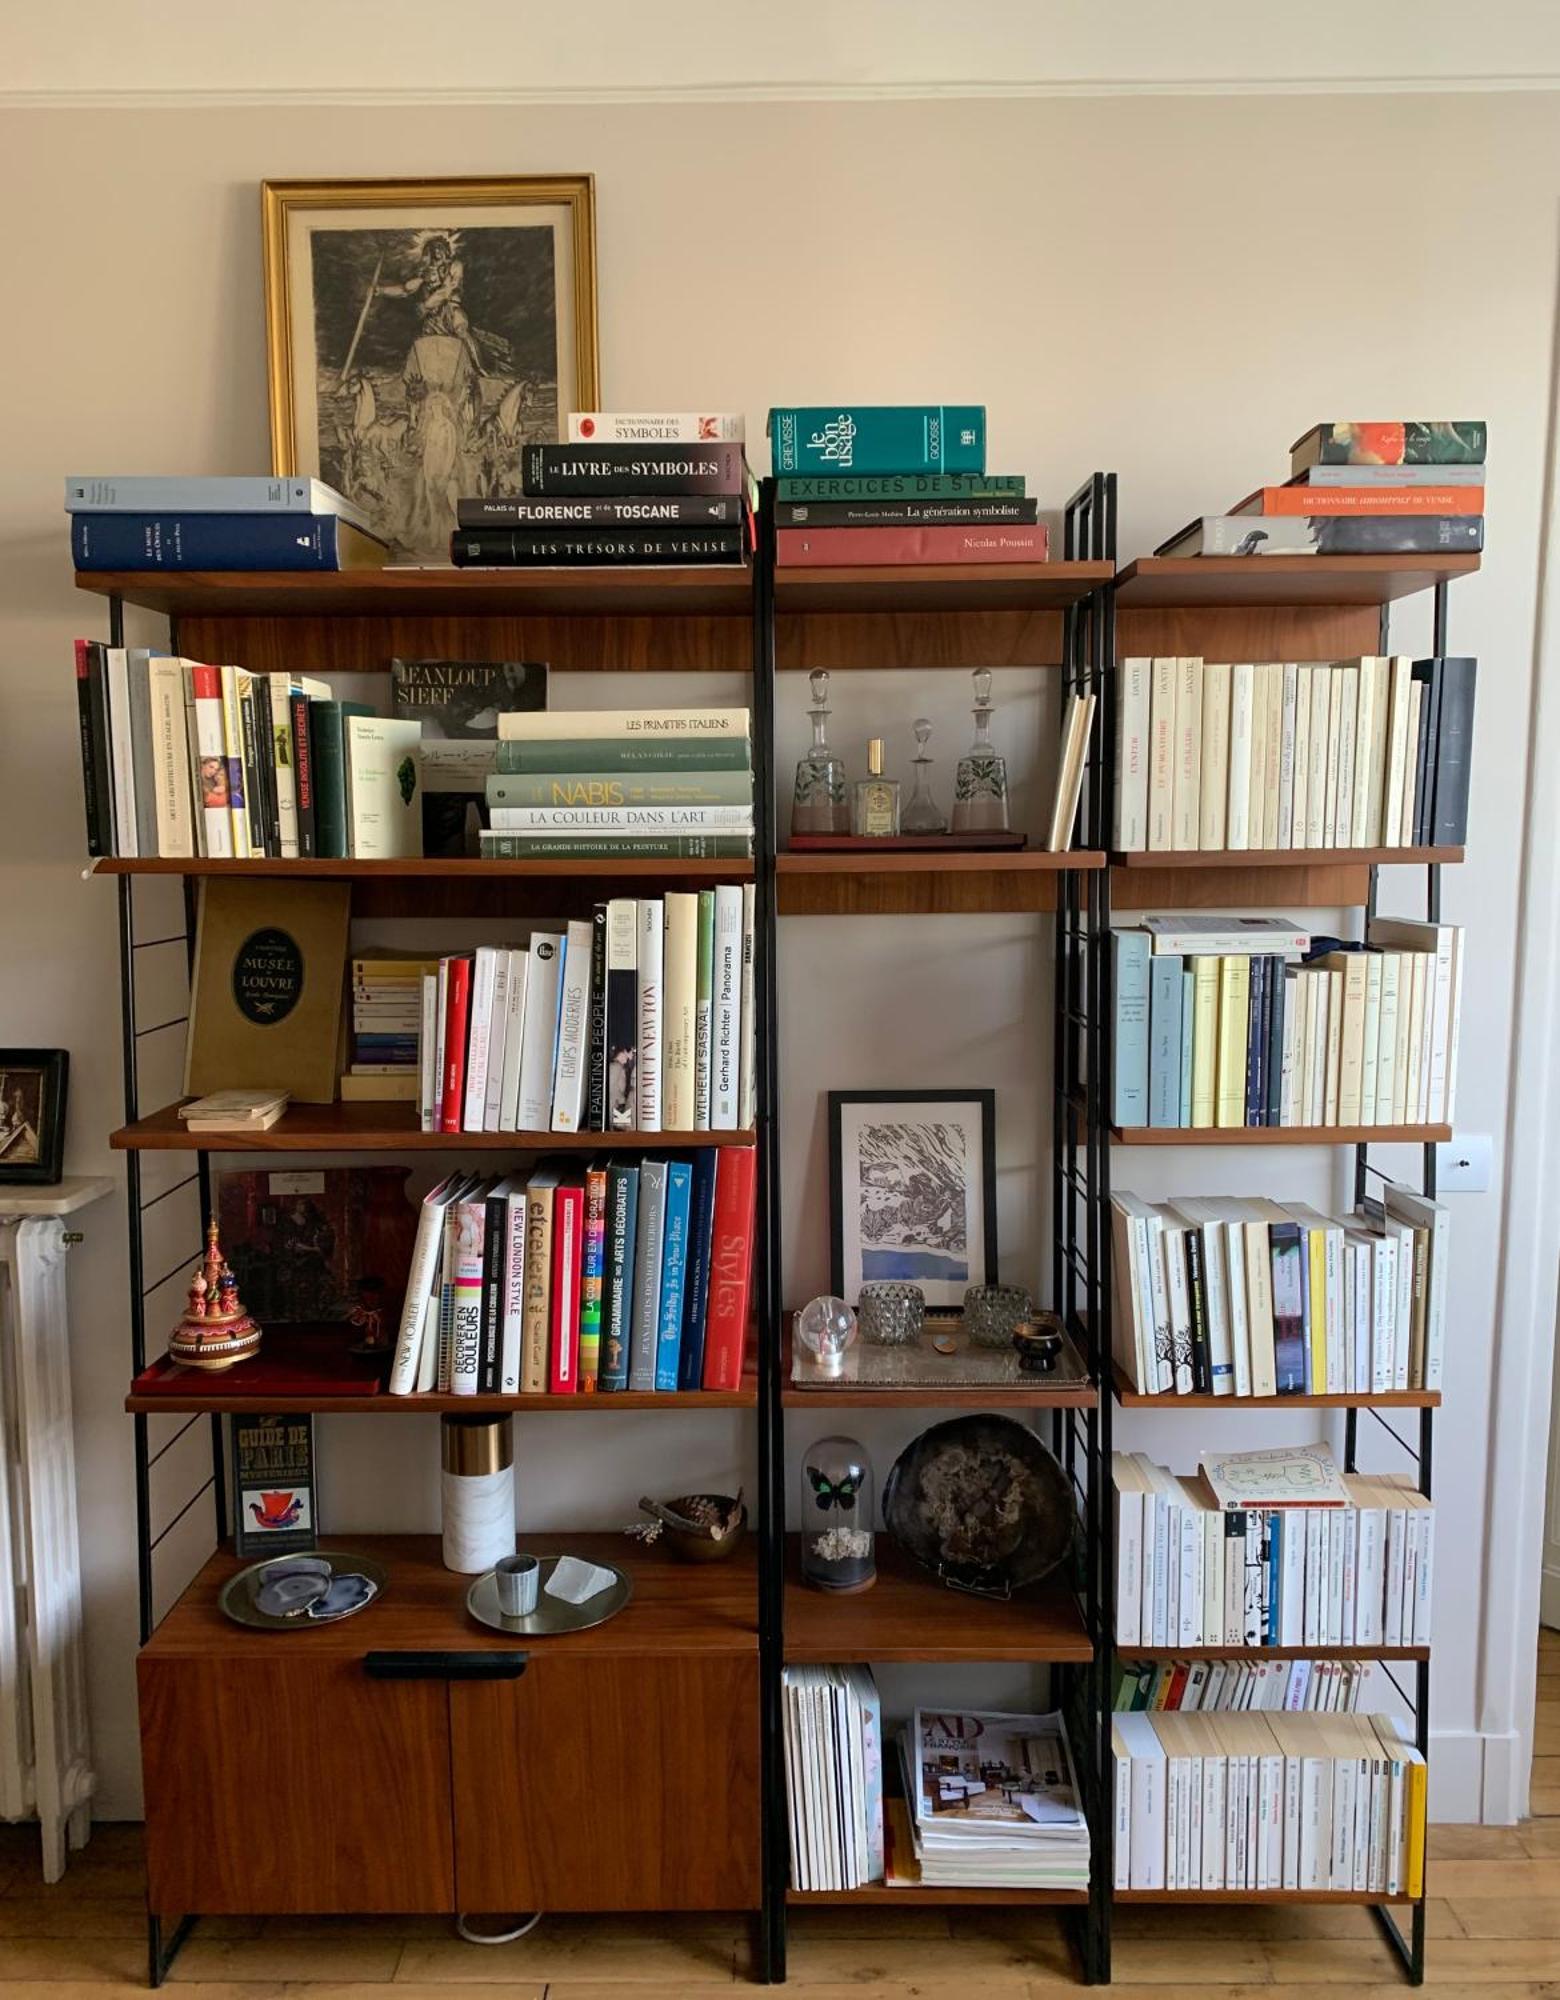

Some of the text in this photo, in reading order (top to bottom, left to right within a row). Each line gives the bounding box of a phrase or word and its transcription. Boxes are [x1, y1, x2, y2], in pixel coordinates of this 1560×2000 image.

[615, 426, 680, 439] SYMBOLES
[782, 414, 794, 470] GREVISSE
[806, 432, 826, 449] le
[820, 422, 840, 461] bon
[837, 413, 857, 467] usage
[929, 417, 941, 460] GOOSSE
[550, 462, 719, 476] LE LIVRE DES SYMBOLES
[789, 475, 1017, 497] EXERCICES DE STYLE
[484, 504, 508, 512] PALAIS
[518, 505, 593, 520] FLORENCE
[614, 505, 680, 518] TOSCANE
[907, 506, 921, 517] La
[922, 505, 971, 520] génération
[972, 504, 1020, 520] symboliste
[531, 540, 728, 555] LES TRÉSORS DE VENISE
[963, 537, 1034, 549] Nicolas Poussin
[397, 667, 496, 687] JEANLOUP
[1131, 666, 1142, 697] DANTE
[1185, 662, 1194, 694] DANTE
[397, 687, 455, 705] SIEFF
[626, 718, 730, 731] LES PRIMITIFS ITALIENS
[295, 703, 312, 809] VENISE INSOLITE ET SECRÈTE
[551, 781, 625, 806] NABIS
[529, 810, 706, 824] LA COULEUR DANS L'ART
[530, 842, 669, 851] LA GRANDE HISTOIRE DE LA PEINTURE
[645, 907, 653, 933] TASCHEN
[718, 945, 733, 1093] Gerhard Richter Panorama
[560, 987, 583, 1079] TEMPS MODERNES
[591, 991, 605, 1114] PAINTING PEOPLE
[640, 981, 657, 1121] HELMUT NEWTON
[697, 1006, 710, 1121] WILHELM SASNAL
[613, 1176, 628, 1236] DÉCORATIFS
[645, 1204, 657, 1259] INTERIORS
[528, 1201, 549, 1301] etcetera
[585, 1177, 600, 1313] LA COULEUR EN DÉCORATION
[613, 1238, 626, 1264] ARTS
[509, 1206, 525, 1316] NEW LONDON STYLE
[667, 1266, 679, 1276] in
[665, 1278, 679, 1290] Is
[711, 1234, 749, 1319] Styles
[609, 1277, 624, 1337] GRAMMAIRE
[663, 1292, 680, 1321] Selby
[454, 1305, 467, 1375] DÉCORER EN
[463, 1305, 479, 1375] COULEURS
[660, 1322, 677, 1343] The
[398, 1343, 412, 1369] NEW
[239, 1425, 308, 1447] GUIDE DE
[240, 1447, 309, 1469] PARIS
[925, 1714, 985, 1738] AD
